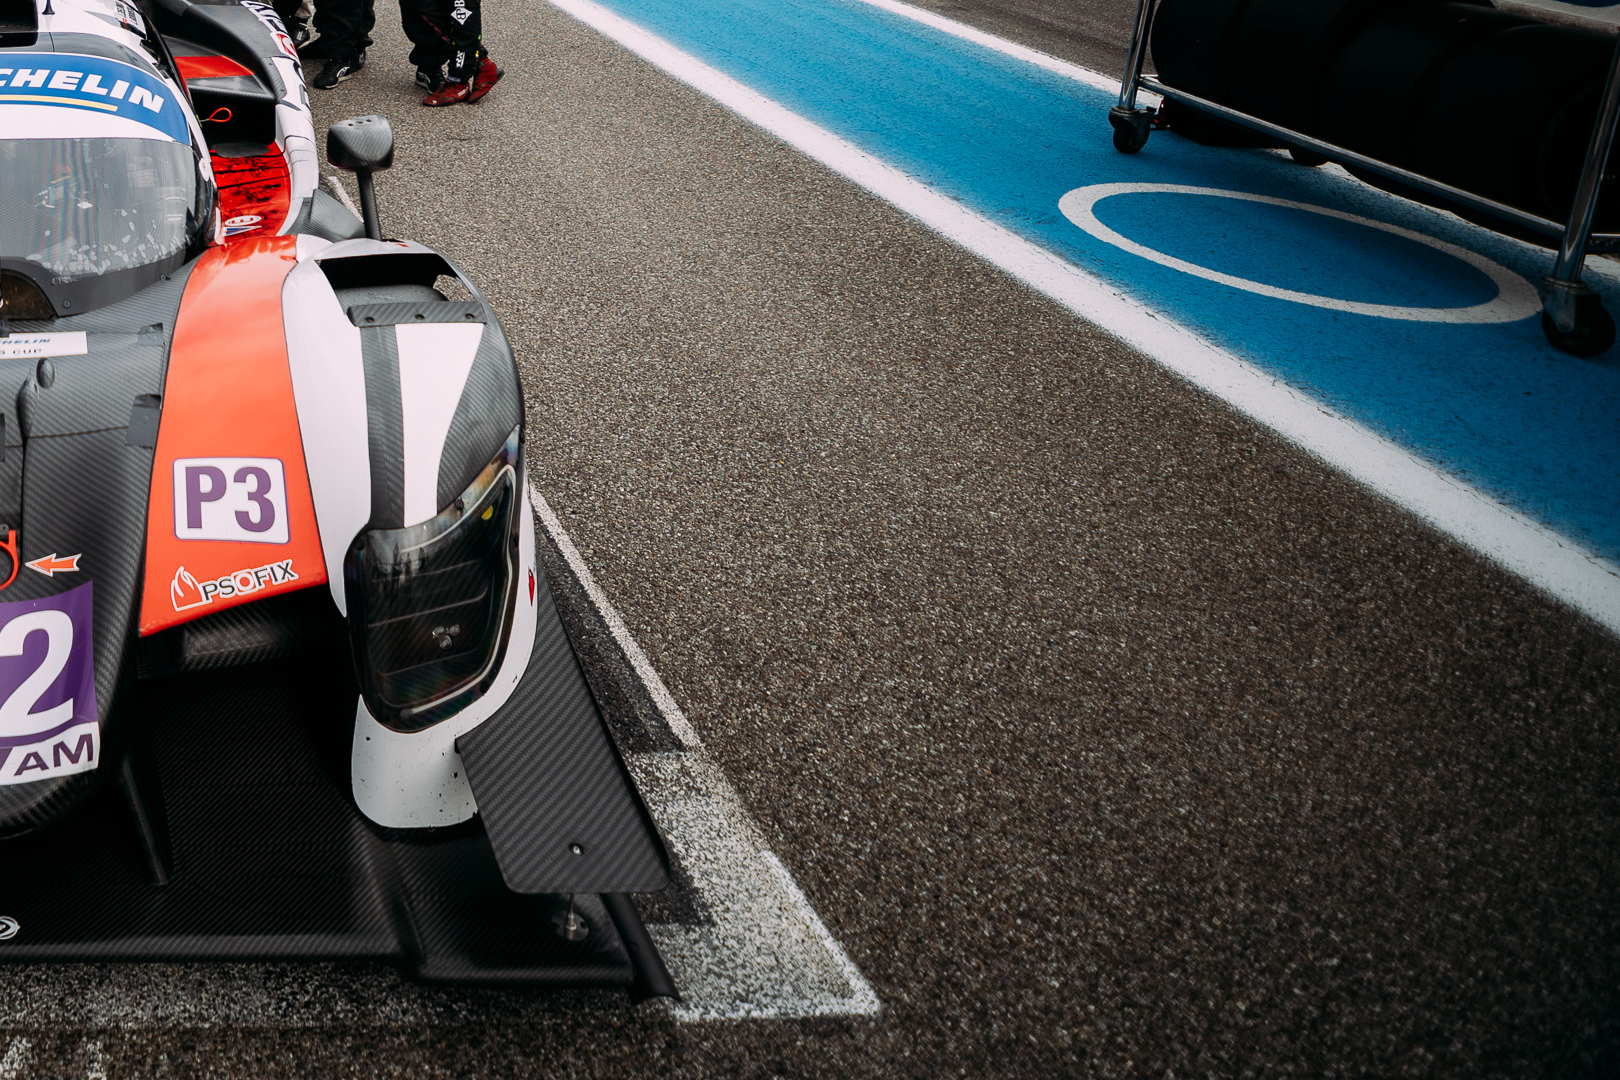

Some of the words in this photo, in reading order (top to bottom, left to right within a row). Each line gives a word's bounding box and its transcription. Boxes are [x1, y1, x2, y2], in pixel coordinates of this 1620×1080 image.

[184, 465, 278, 532] P3
[198, 560, 300, 604] PSOFIX
[13, 732, 95, 778] AM
